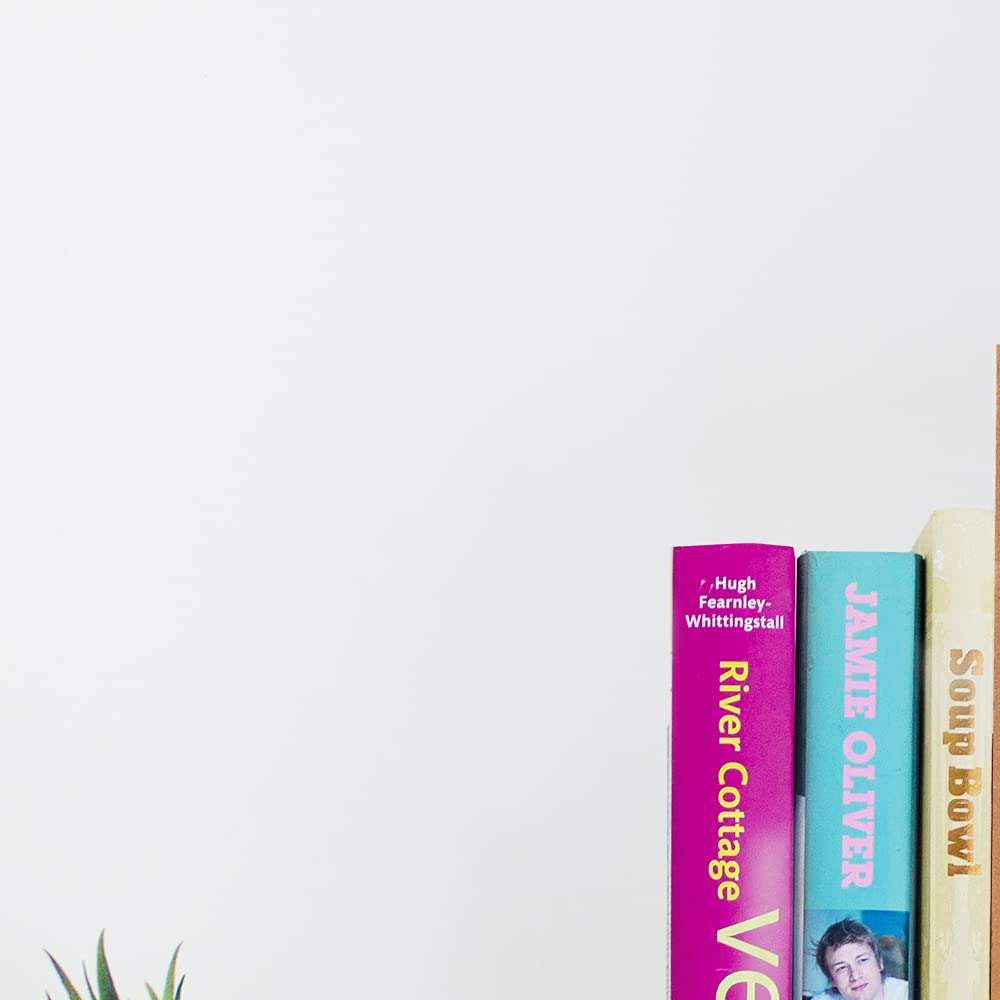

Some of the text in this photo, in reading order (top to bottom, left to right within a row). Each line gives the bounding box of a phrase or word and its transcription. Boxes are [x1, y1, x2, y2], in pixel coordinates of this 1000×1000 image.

[685, 614, 784, 632] Whittingstall
[699, 595, 772, 613] Fearnley-
[715, 576, 757, 594] Hugh
[718, 661, 750, 751] River
[841, 584, 878, 889] JAMIE OLIVER
[942, 649, 984, 877] Soup Bowl
[709, 762, 748, 901] Cottage
